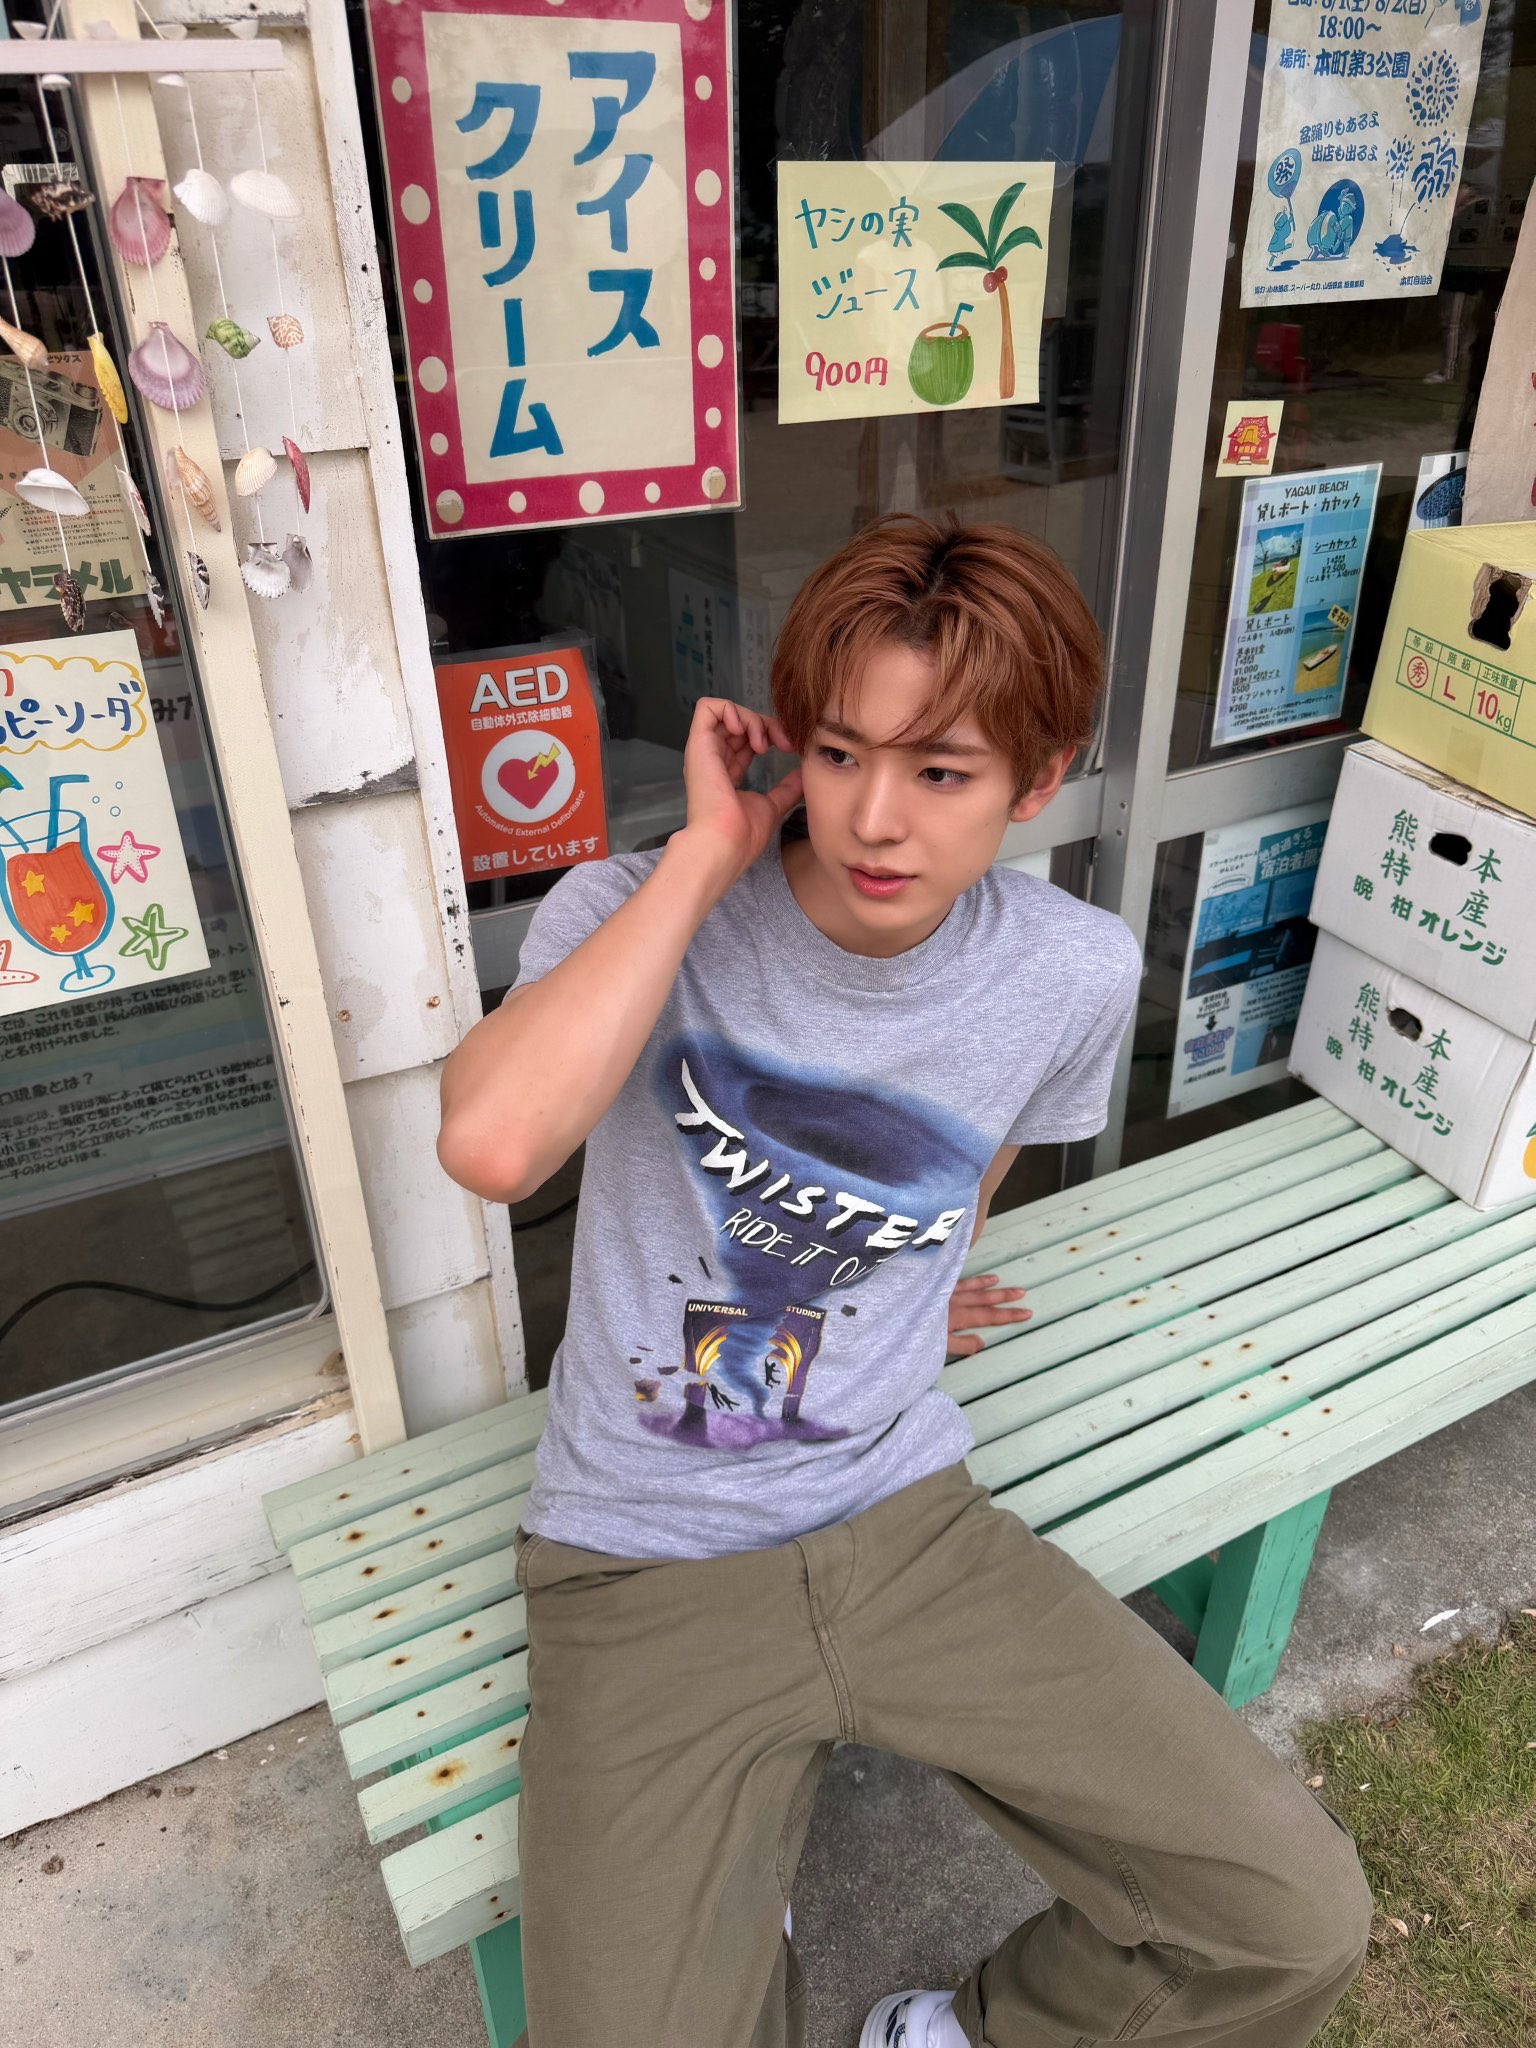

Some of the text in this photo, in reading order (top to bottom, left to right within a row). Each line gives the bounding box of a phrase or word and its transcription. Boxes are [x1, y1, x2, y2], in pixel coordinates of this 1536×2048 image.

[1314, 48, 1411, 78] 本町第3公園
[1300, 111, 1380, 145] 盆踊りもあるよ
[1311, 145, 1378, 162] 出店も出るよ
[1274, 155, 1295, 185] 祭
[567, 51, 661, 358] アイス
[795, 196, 919, 249] ヤシの実
[455, 81, 565, 458] クリーム
[811, 268, 920, 319] ジュース
[805, 352, 888, 391] 900円
[1285, 480, 1349, 498] YAGAJI BEACH
[1256, 494, 1361, 522] 貸しボート・カヤック
[1314, 537, 1358, 552] シーカヤック
[1245, 615, 1290, 632] 貸しボート
[469, 663, 570, 714] AED
[1443, 675, 1456, 701] L
[1482, 666, 1519, 692] 正味重量
[470, 705, 573, 731] 自動体外式除細動器
[475, 789, 586, 837] Automated External Defibrillator
[472, 836, 599, 872] 設置しています
[675, 1058, 966, 1249] TWISTER
[720, 1207, 793, 1259] RIDE
[790, 1242, 838, 1267] IT
[687, 1303, 822, 1320] UNIVERSAL STUDIOS
